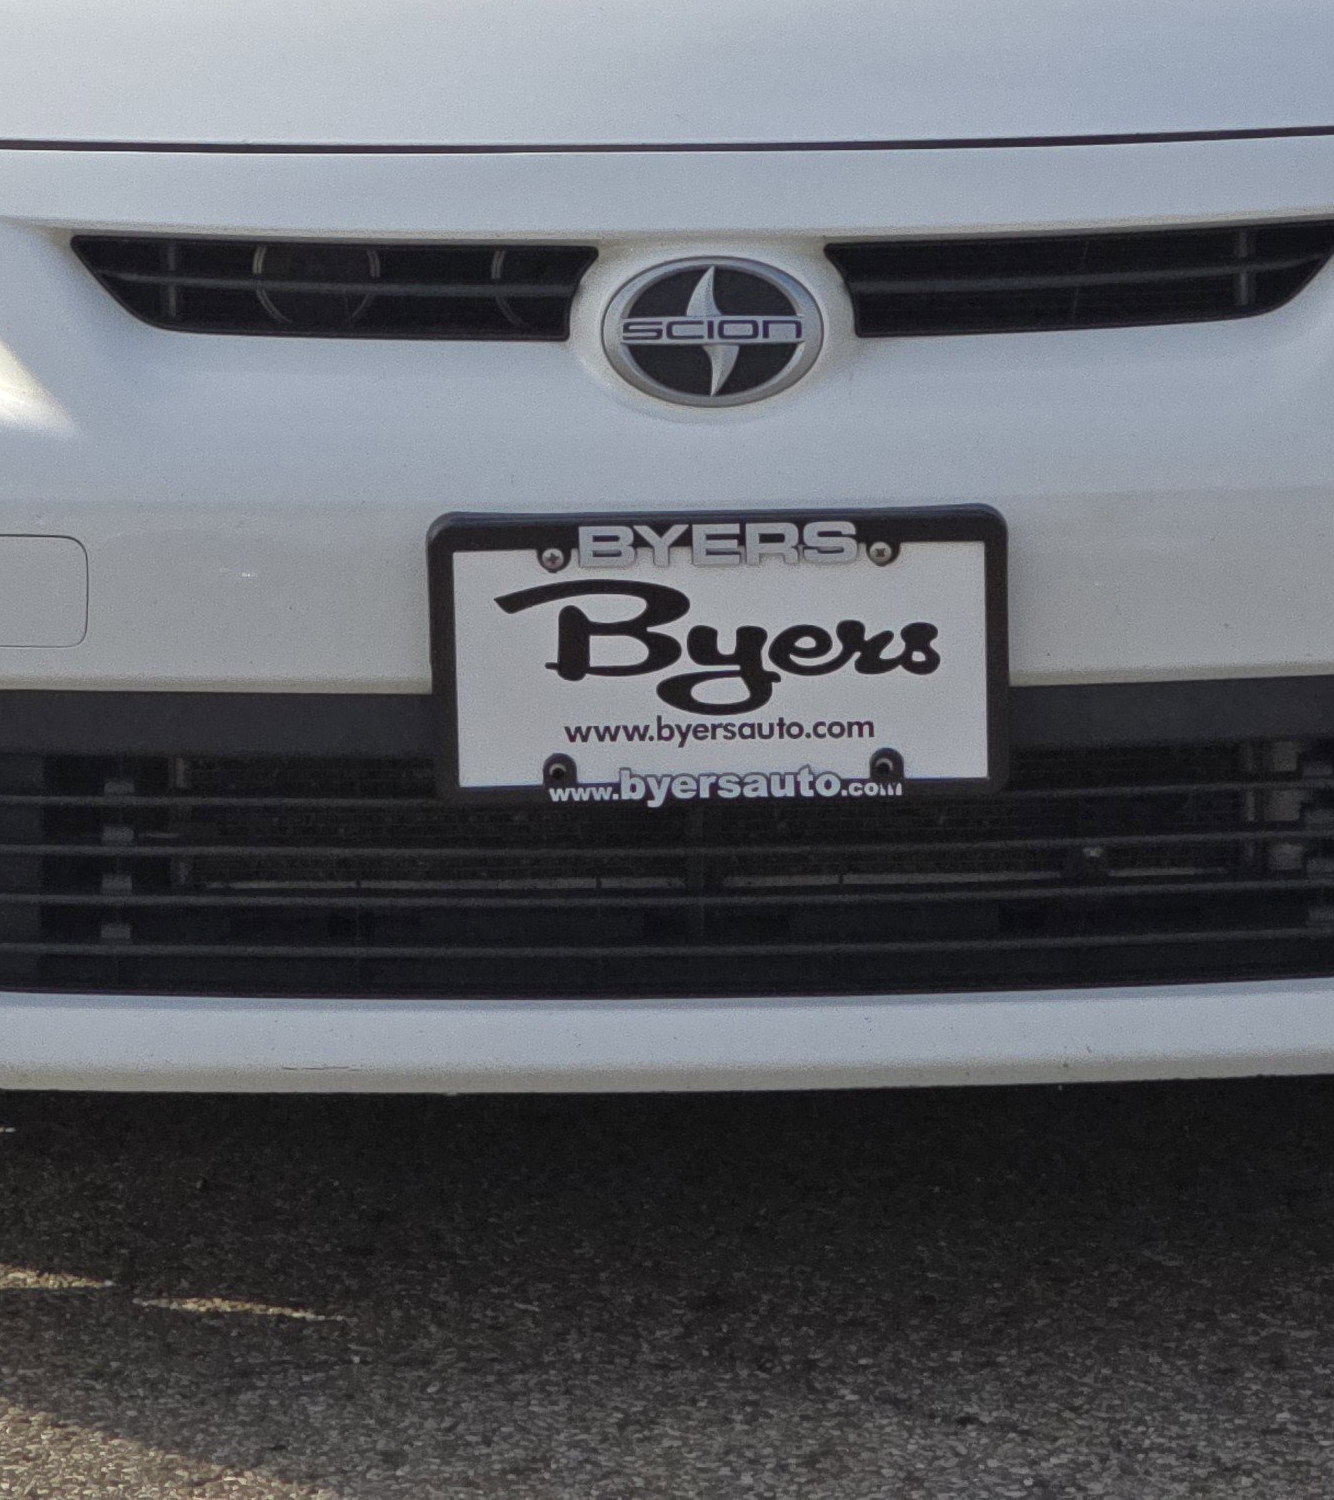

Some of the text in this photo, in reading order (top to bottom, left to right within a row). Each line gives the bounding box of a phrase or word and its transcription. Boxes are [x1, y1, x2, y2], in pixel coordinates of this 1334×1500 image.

[622, 319, 803, 341] SCION
[577, 521, 859, 569] BYERS
[493, 578, 942, 716] Byers
[563, 715, 875, 748] www.byersauto.com
[548, 764, 904, 809] www.byersauto.com
